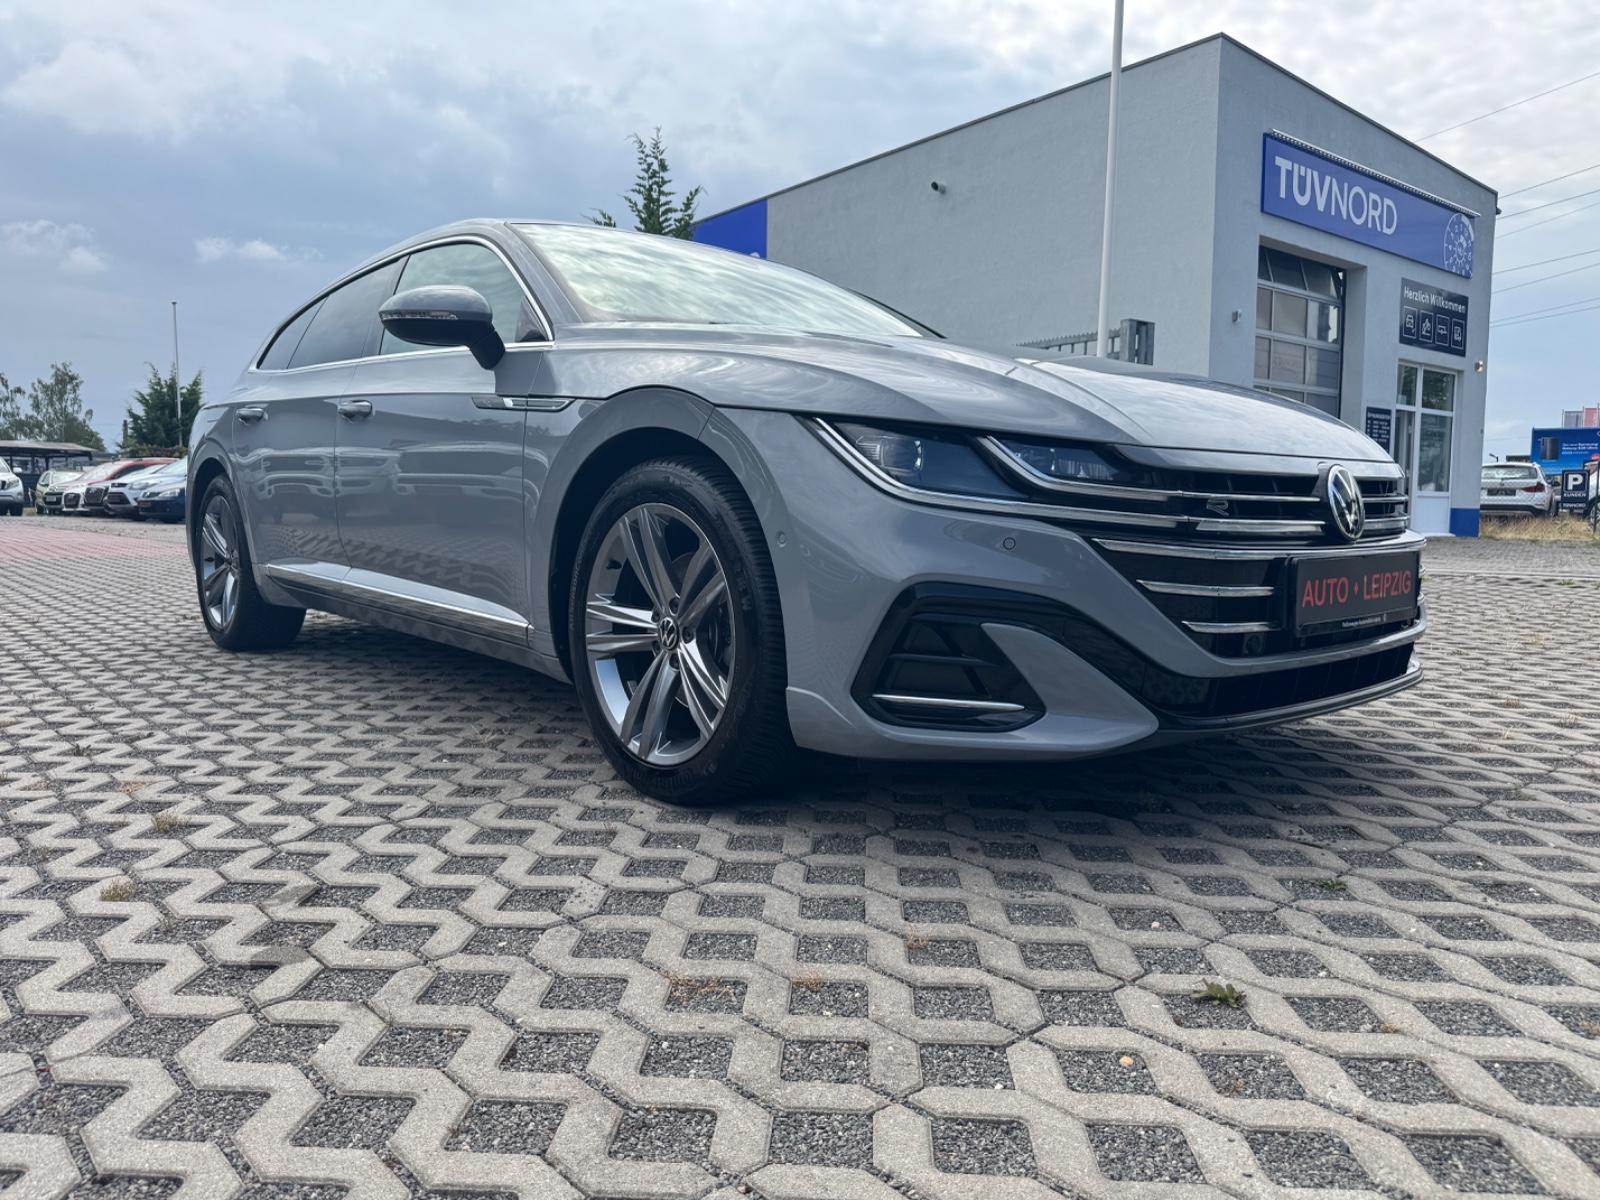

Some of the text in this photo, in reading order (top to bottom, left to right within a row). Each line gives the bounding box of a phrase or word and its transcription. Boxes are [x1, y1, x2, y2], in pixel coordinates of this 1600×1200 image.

[1404, 286, 1466, 314] Herzlich Willkommen
[1568, 474, 1583, 490] P
[1302, 570, 1411, 608] AUTO LEIPZIG
